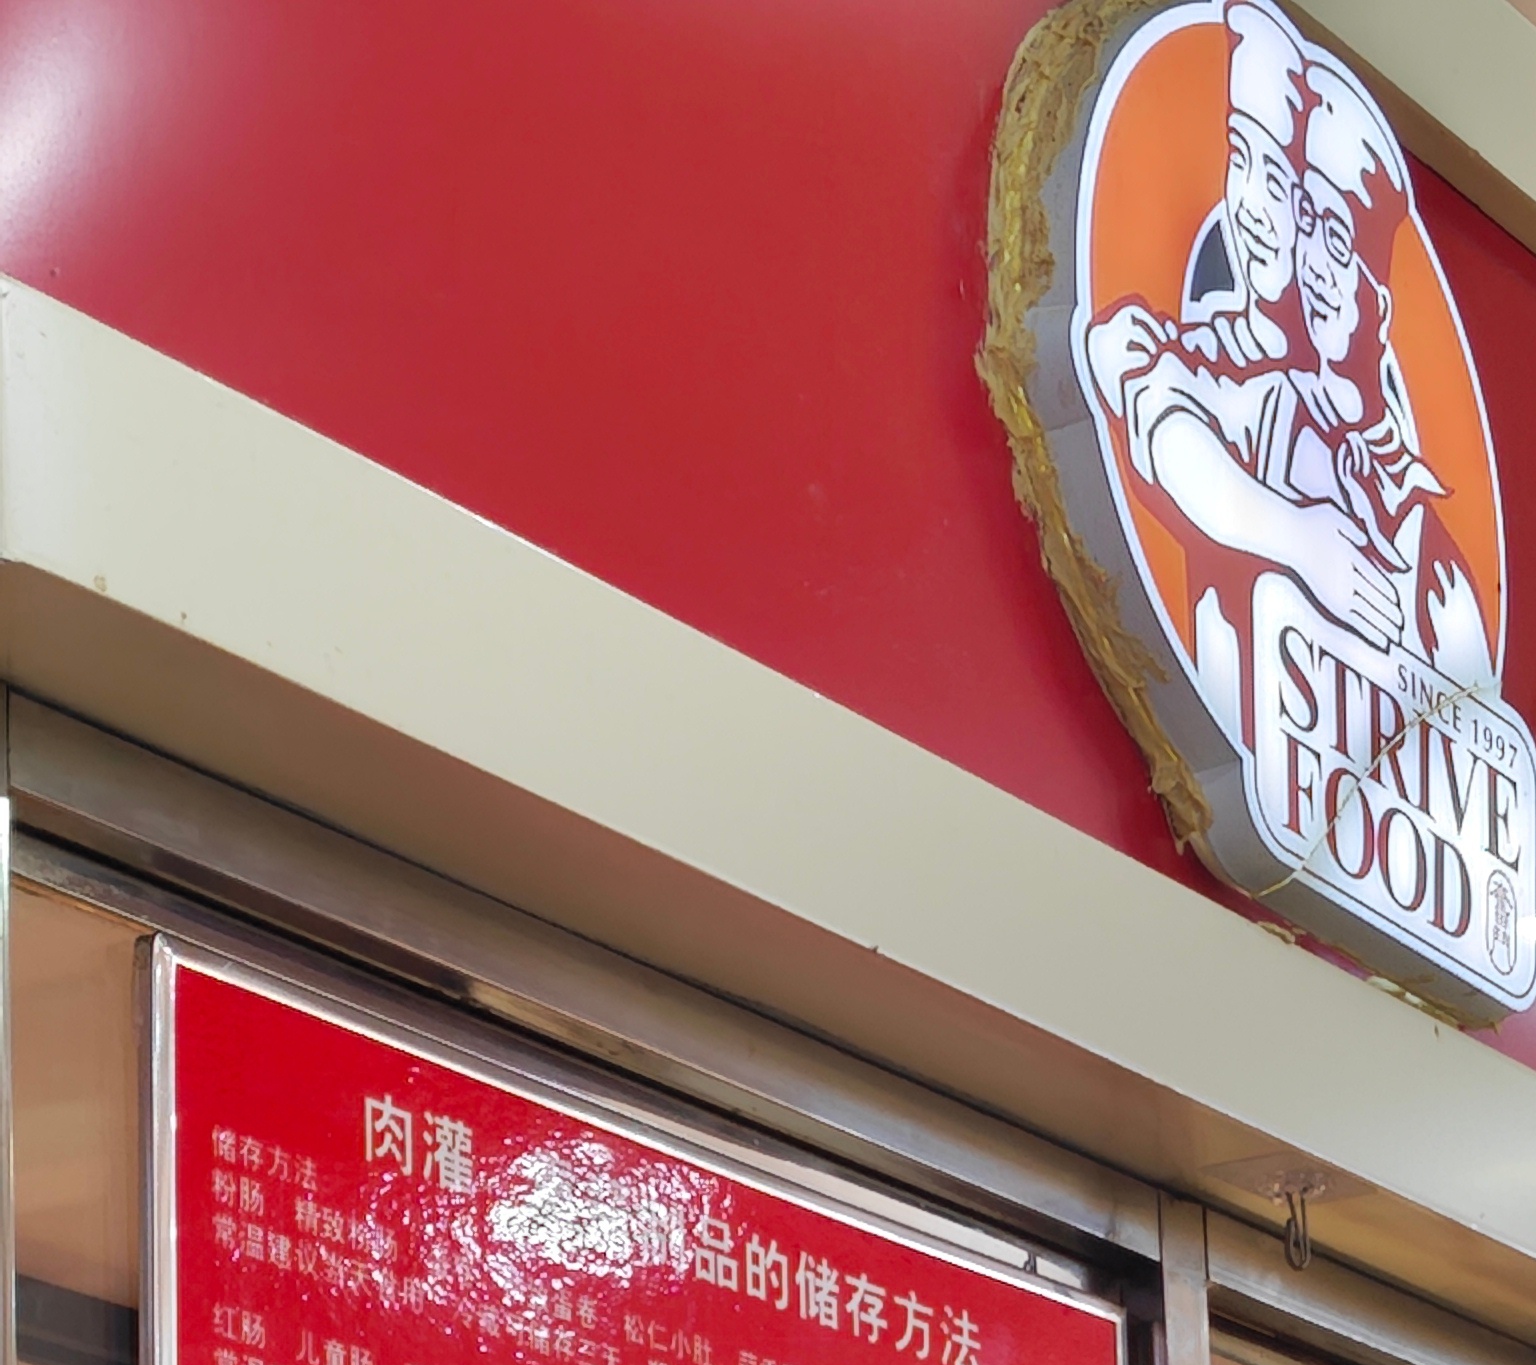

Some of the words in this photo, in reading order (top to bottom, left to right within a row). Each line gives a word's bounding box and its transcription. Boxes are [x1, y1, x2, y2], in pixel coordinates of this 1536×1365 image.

[1278, 625, 1520, 872] STRIVE
[1397, 664, 1462, 734] SINCE
[1472, 719, 1518, 769] 1997
[1280, 728, 1472, 938] FOOD
[212, 1123, 318, 1192] 储存方法
[212, 1167, 264, 1216] 粉肠
[212, 1302, 266, 1351] 红肠
